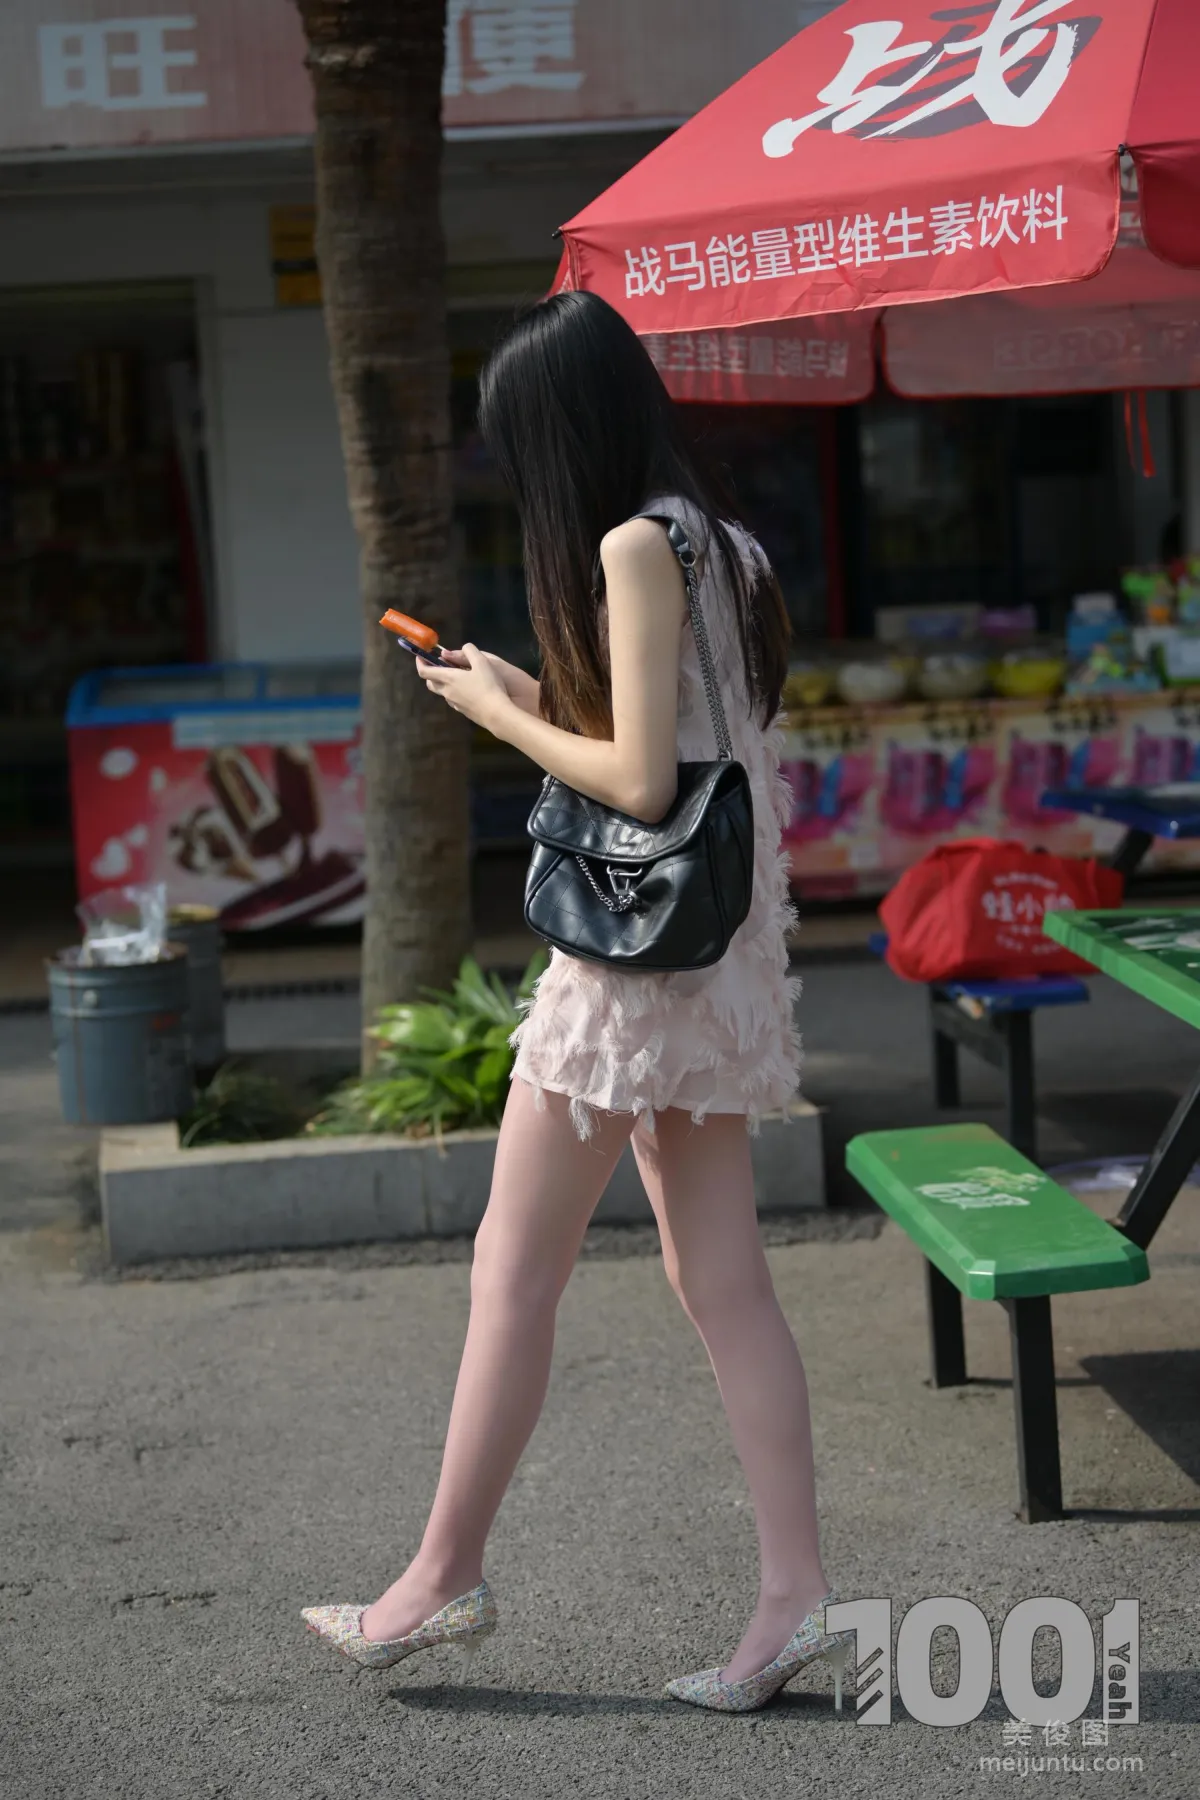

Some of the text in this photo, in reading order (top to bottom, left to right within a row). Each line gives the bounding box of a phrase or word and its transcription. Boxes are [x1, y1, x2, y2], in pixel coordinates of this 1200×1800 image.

[38, 15, 207, 110] 旺
[624, 185, 1069, 299] 战马能量型维生素饮料
